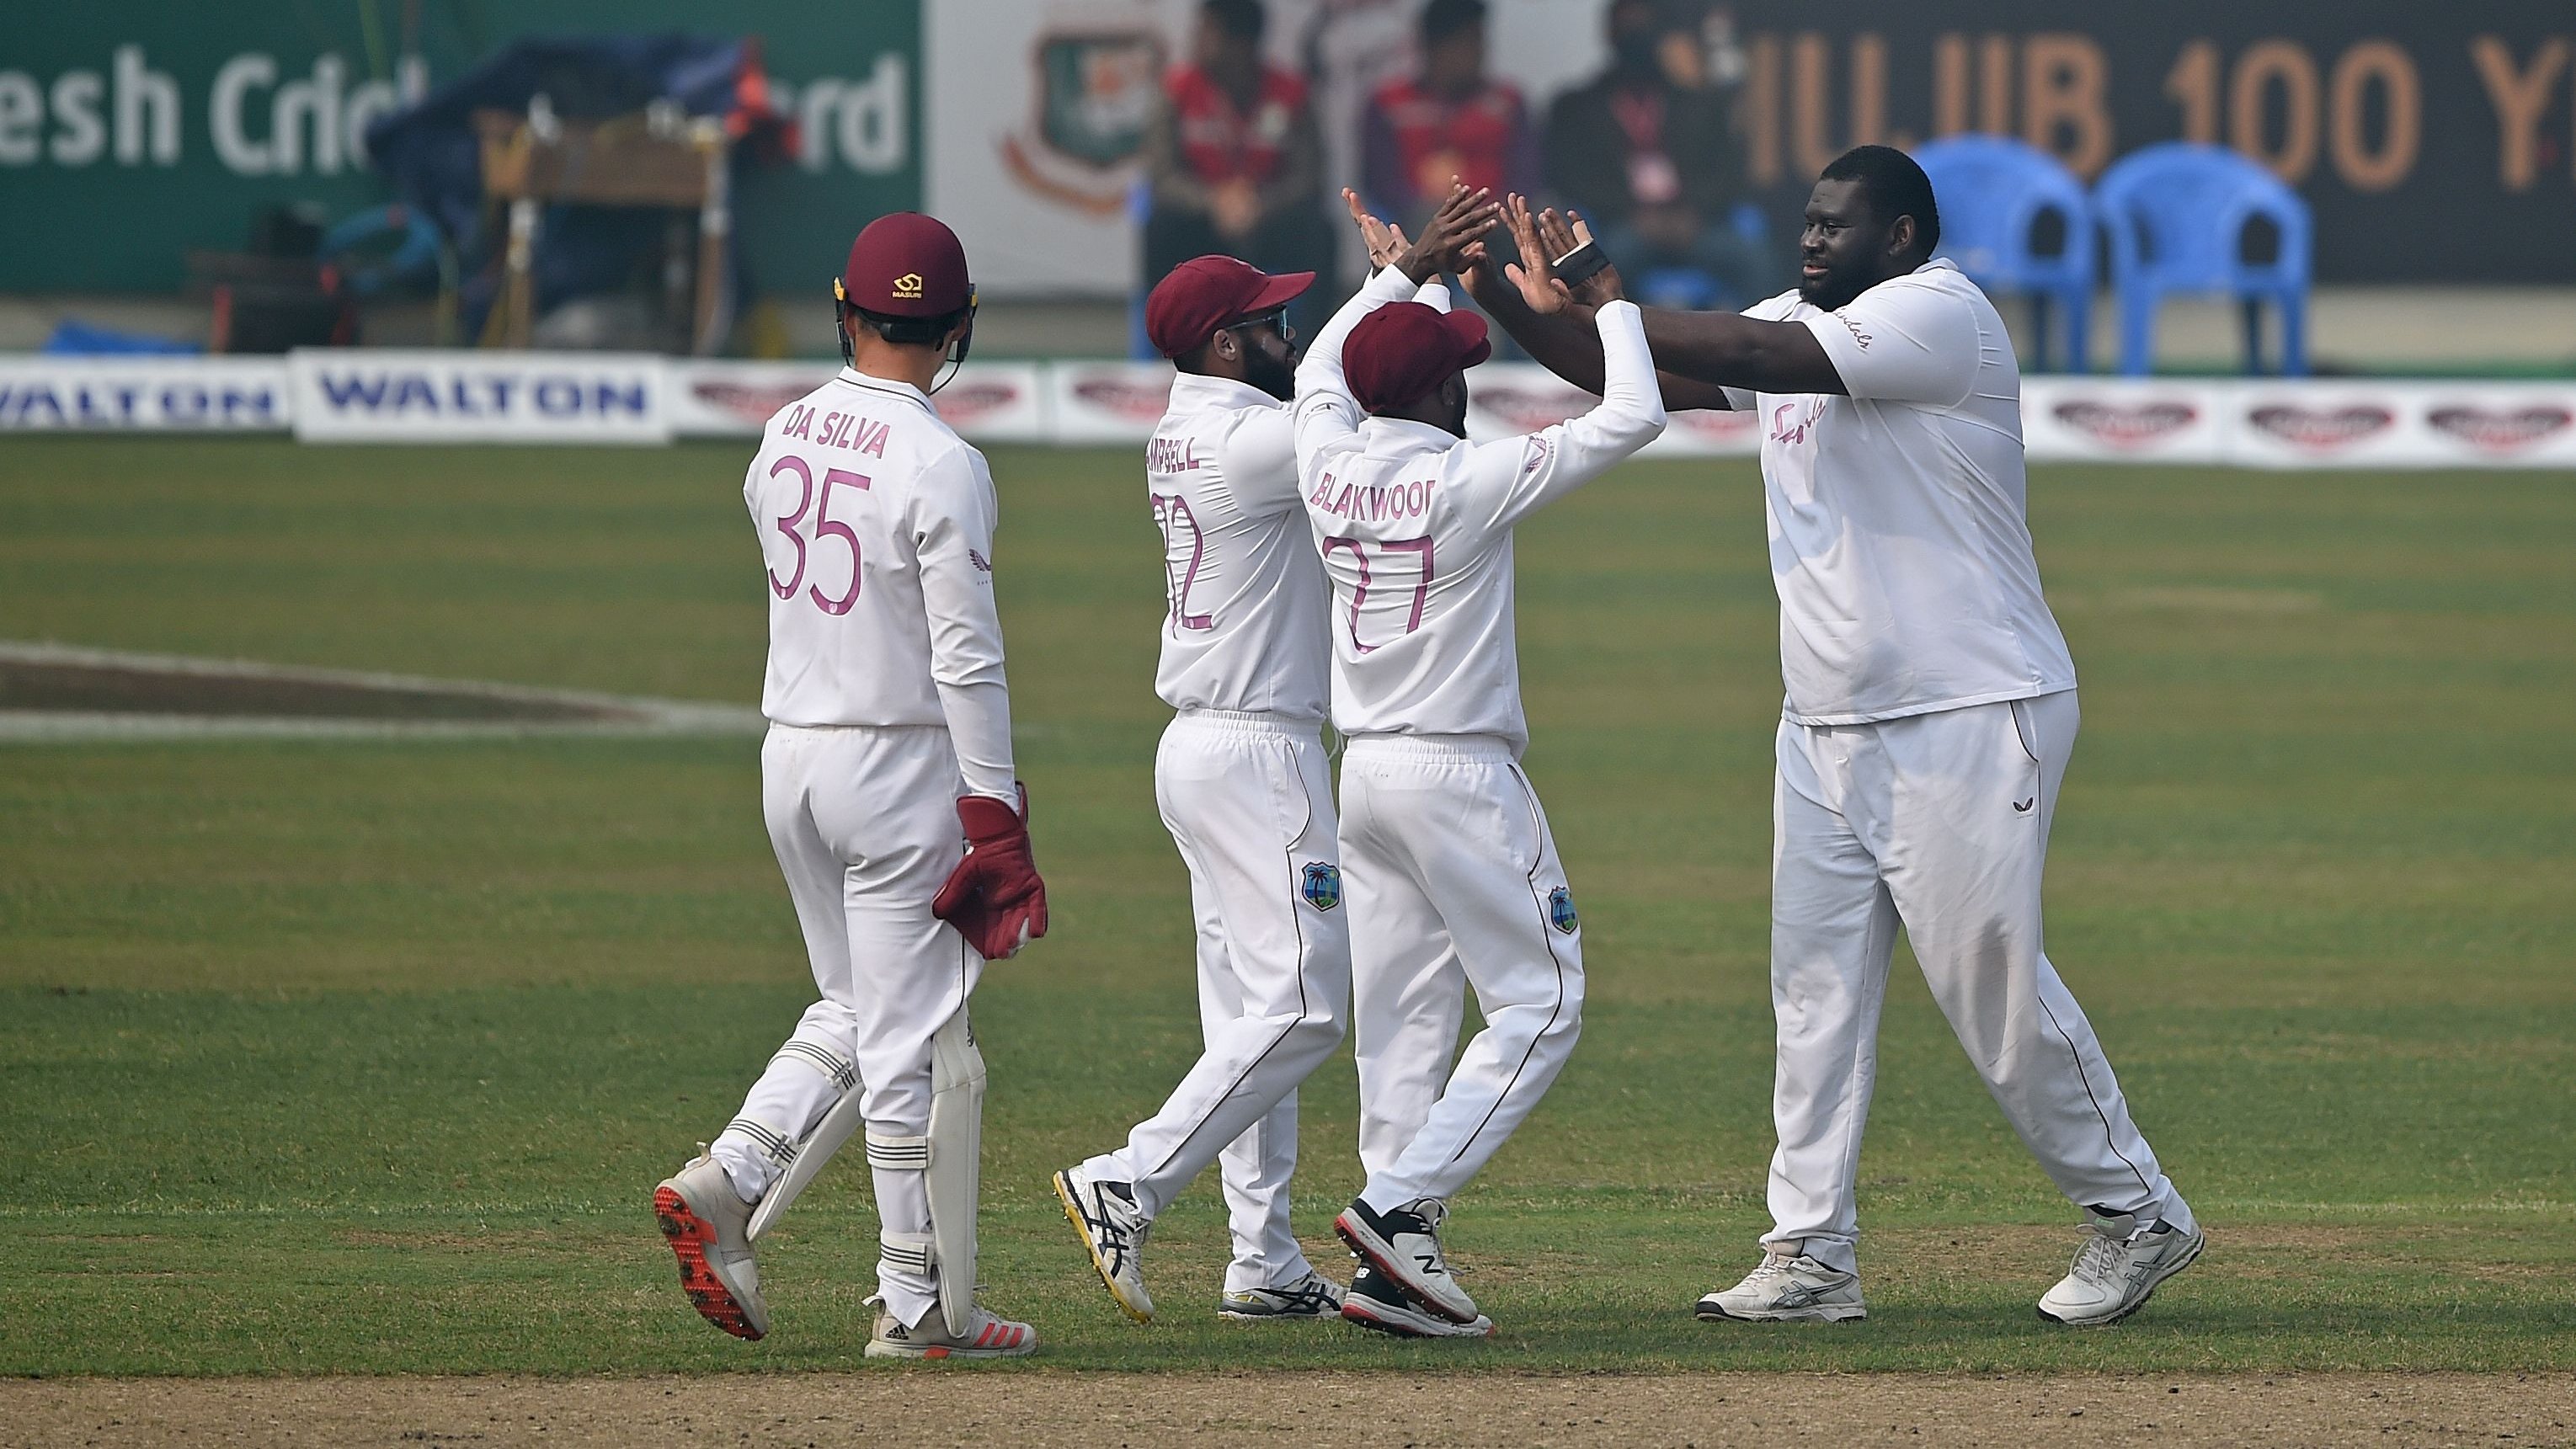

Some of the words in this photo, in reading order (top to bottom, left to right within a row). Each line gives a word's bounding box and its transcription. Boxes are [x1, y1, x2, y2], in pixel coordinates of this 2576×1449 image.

[0, 44, 183, 165] esh
[2166, 37, 2422, 192] 100
[318, 370, 647, 418] WALTON
[782, 404, 816, 441] DA
[816, 412, 891, 460] SILVA
[770, 455, 872, 615] 35
